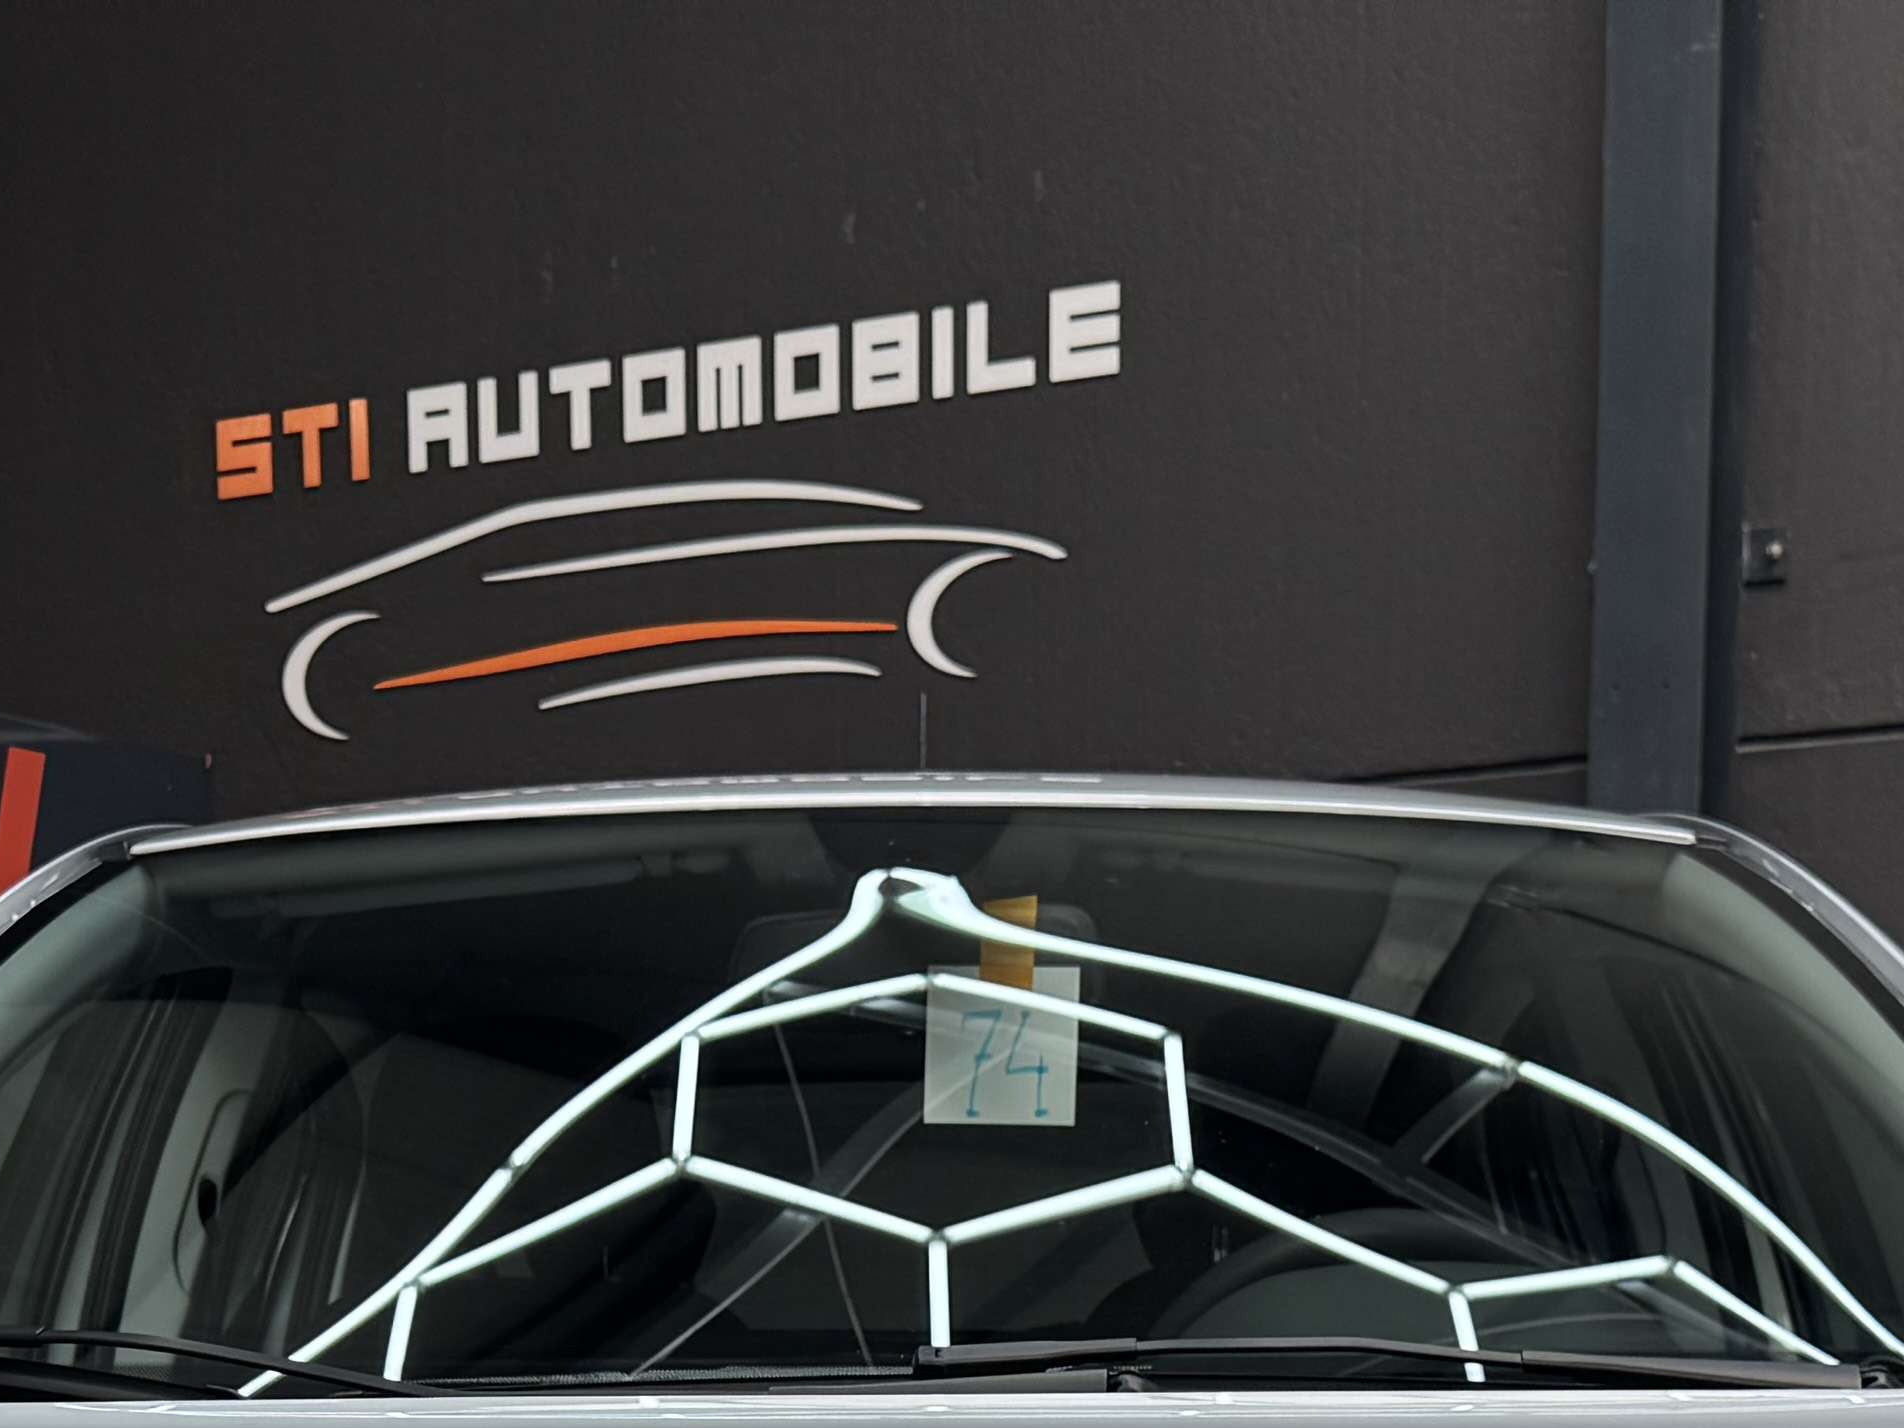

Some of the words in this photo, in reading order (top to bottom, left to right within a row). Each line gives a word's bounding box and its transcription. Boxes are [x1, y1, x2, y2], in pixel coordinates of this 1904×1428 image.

[215, 398, 370, 501] STI
[406, 280, 1121, 474] AUTOMOBILE
[962, 1009, 1049, 1118] 74
